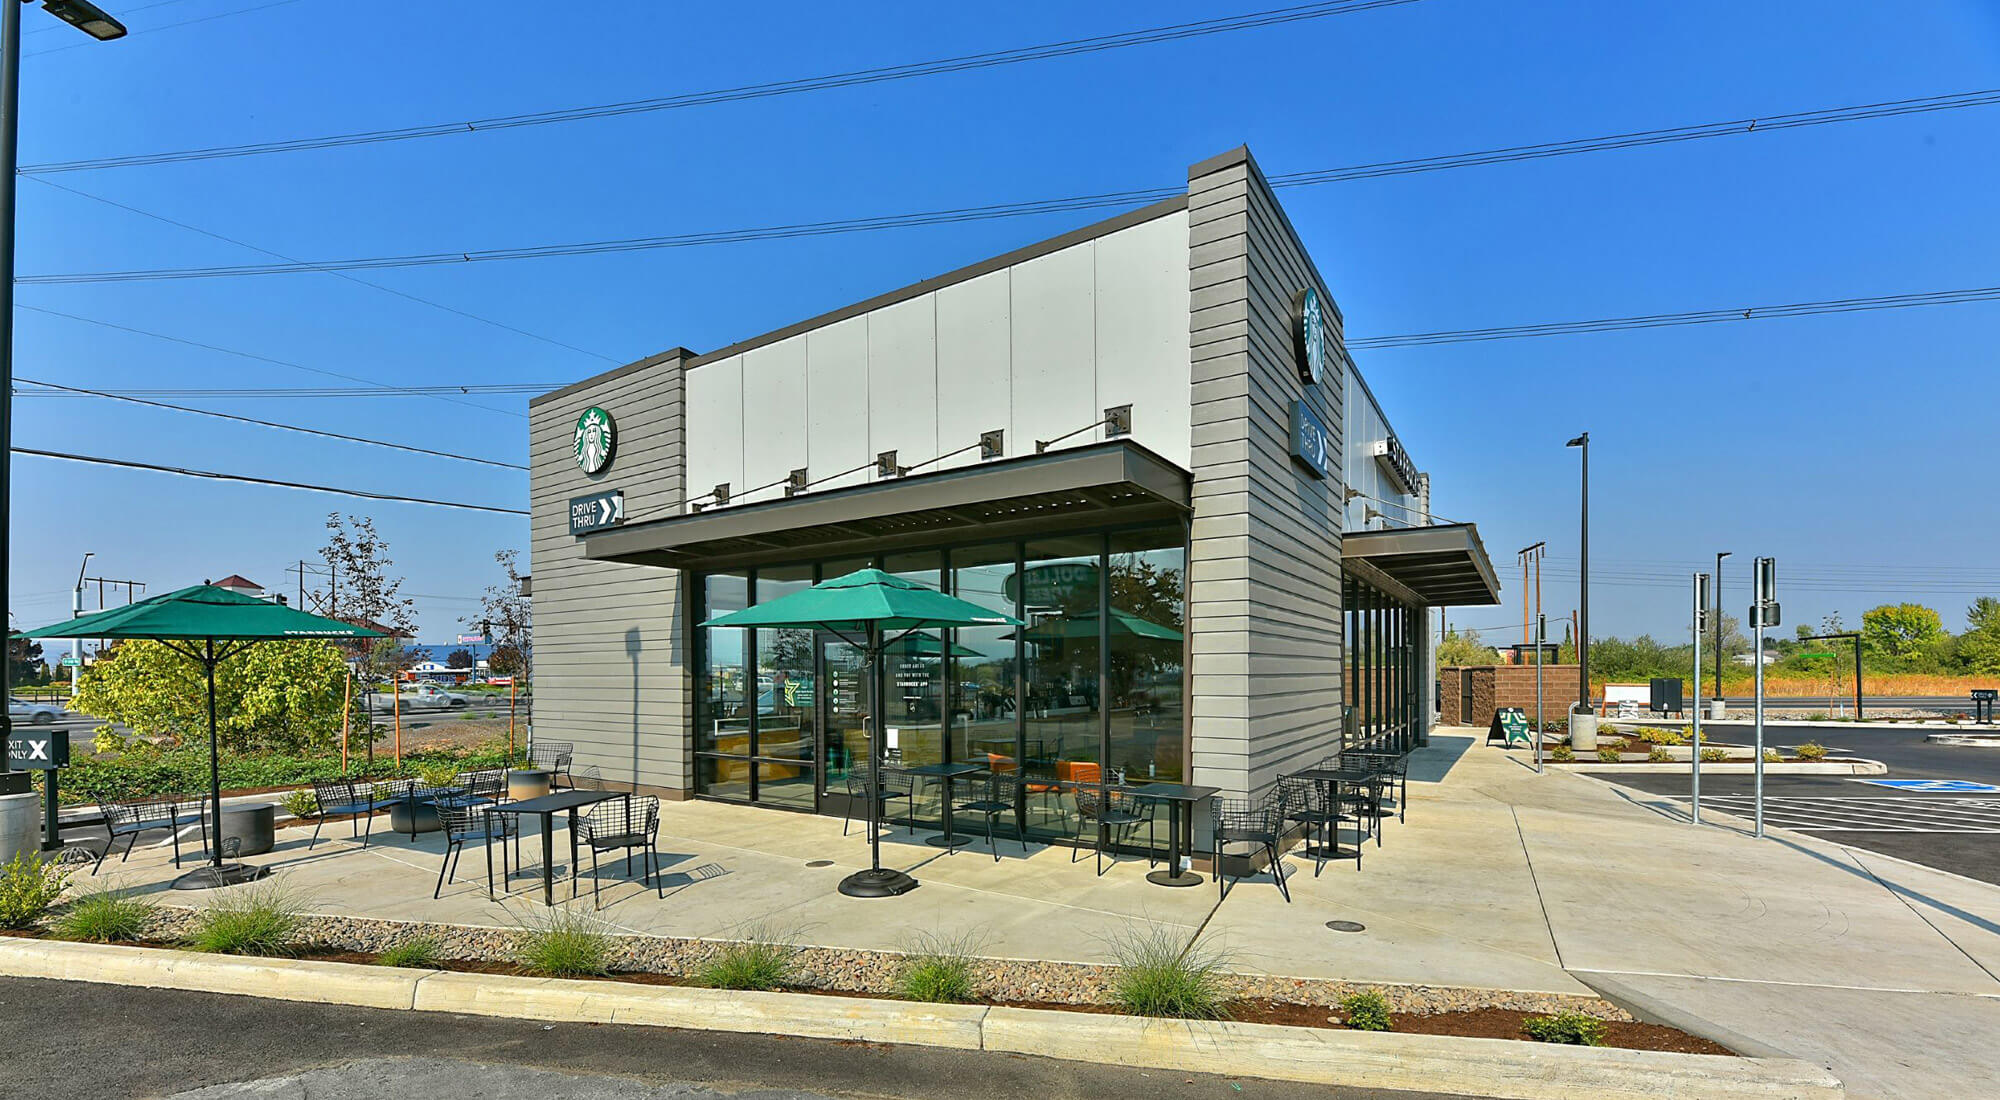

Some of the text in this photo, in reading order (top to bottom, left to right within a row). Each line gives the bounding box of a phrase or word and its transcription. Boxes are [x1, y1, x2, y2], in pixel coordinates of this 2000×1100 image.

[572, 501, 597, 516] DRIVE
[572, 515, 595, 528] THRU
[9, 740, 22, 749] XIT
[9, 750, 28, 760] NLY
